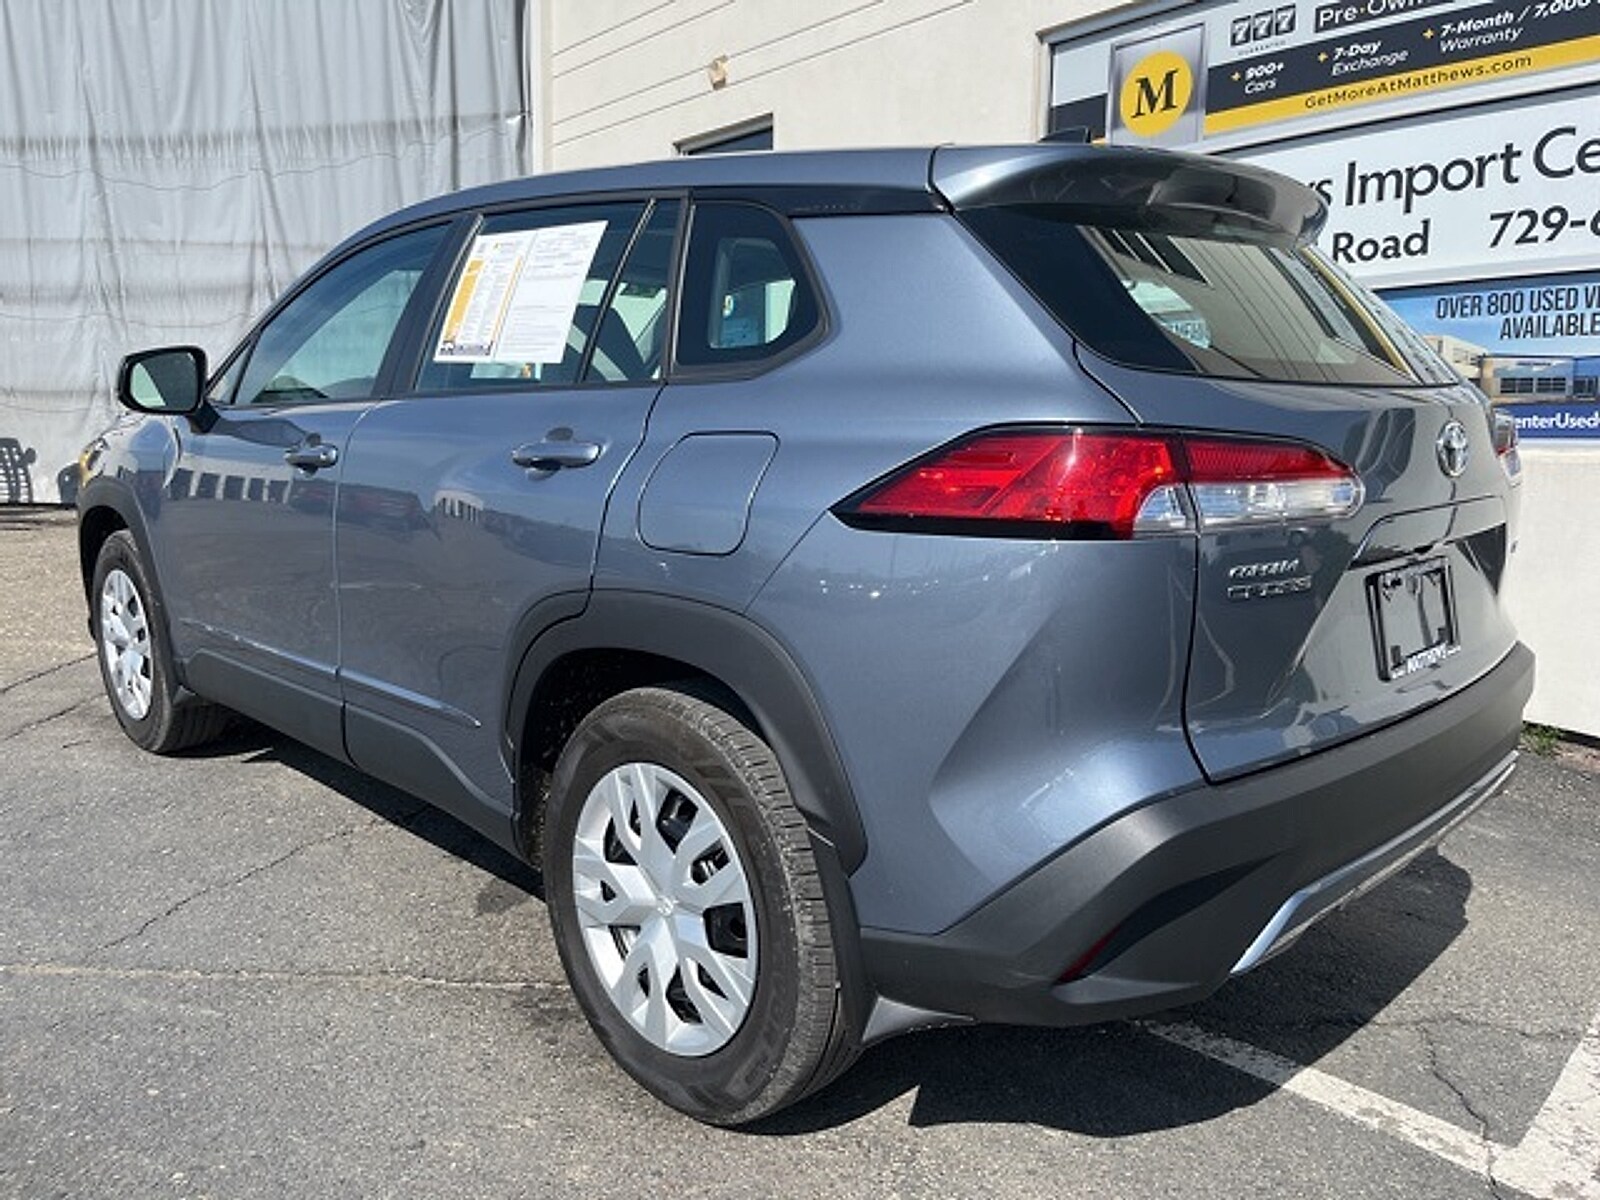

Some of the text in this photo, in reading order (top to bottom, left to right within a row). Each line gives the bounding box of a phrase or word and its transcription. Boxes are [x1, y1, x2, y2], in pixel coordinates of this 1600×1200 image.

[1440, 10, 1514, 38] 7-Month
[1333, 41, 1381, 61] 7-Day
[1440, 27, 1524, 53] Warranty
[1332, 50, 1409, 76] Exchange
[1131, 68, 1178, 119] M
[1245, 78, 1276, 94] Cars
[1305, 55, 1532, 109] GetMoreAtMatthews.com
[1345, 143, 1522, 214] Import
[1332, 218, 1431, 264] Road
[1436, 295, 1482, 320] OVER
[1487, 290, 1523, 316] 800
[1529, 287, 1578, 313] USED
[1500, 313, 1600, 340] AVAILABLE
